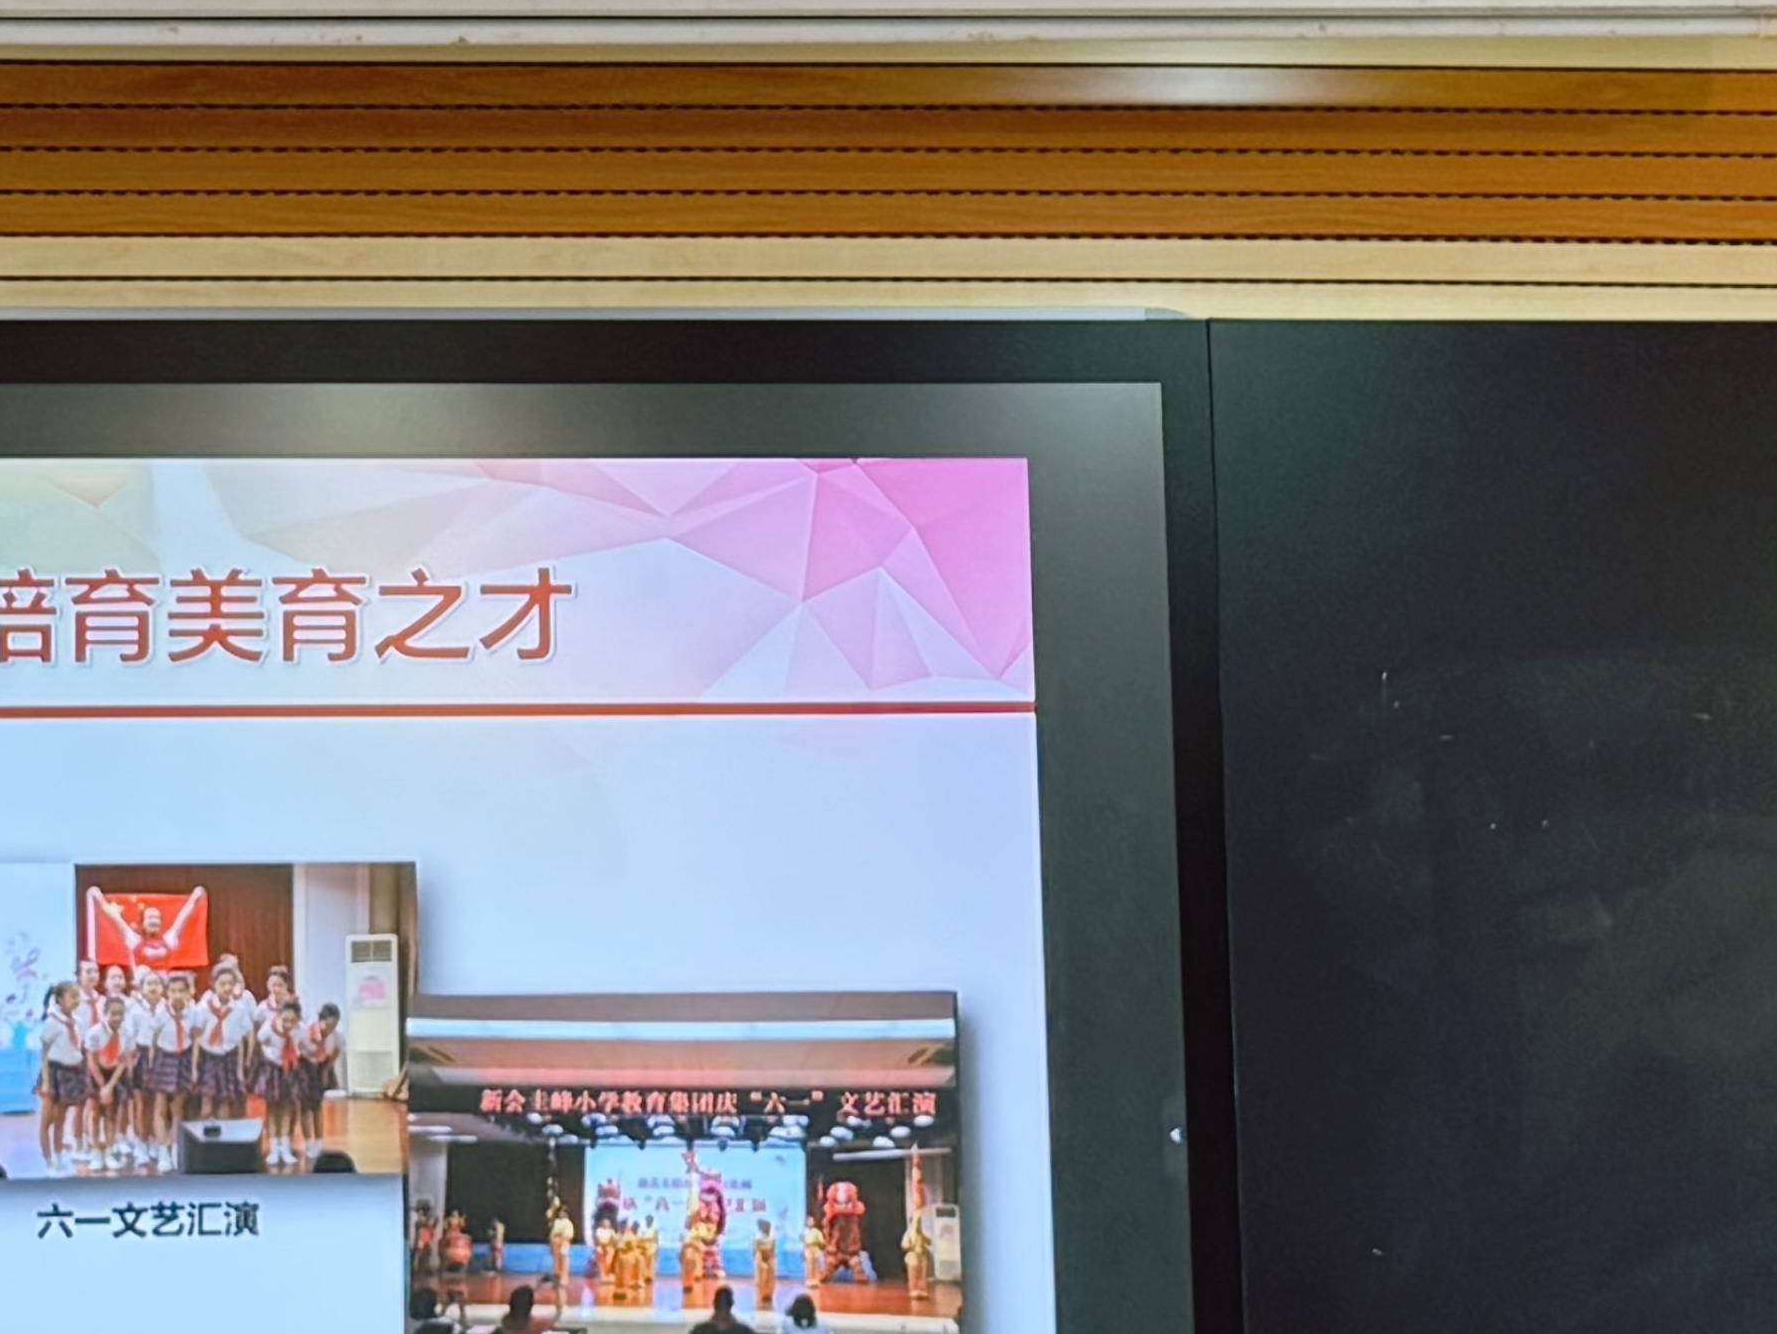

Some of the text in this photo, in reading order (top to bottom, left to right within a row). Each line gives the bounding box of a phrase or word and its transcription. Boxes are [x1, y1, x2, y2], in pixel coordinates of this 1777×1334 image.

[37, 1200, 260, 1238] 六一文艺汇演
